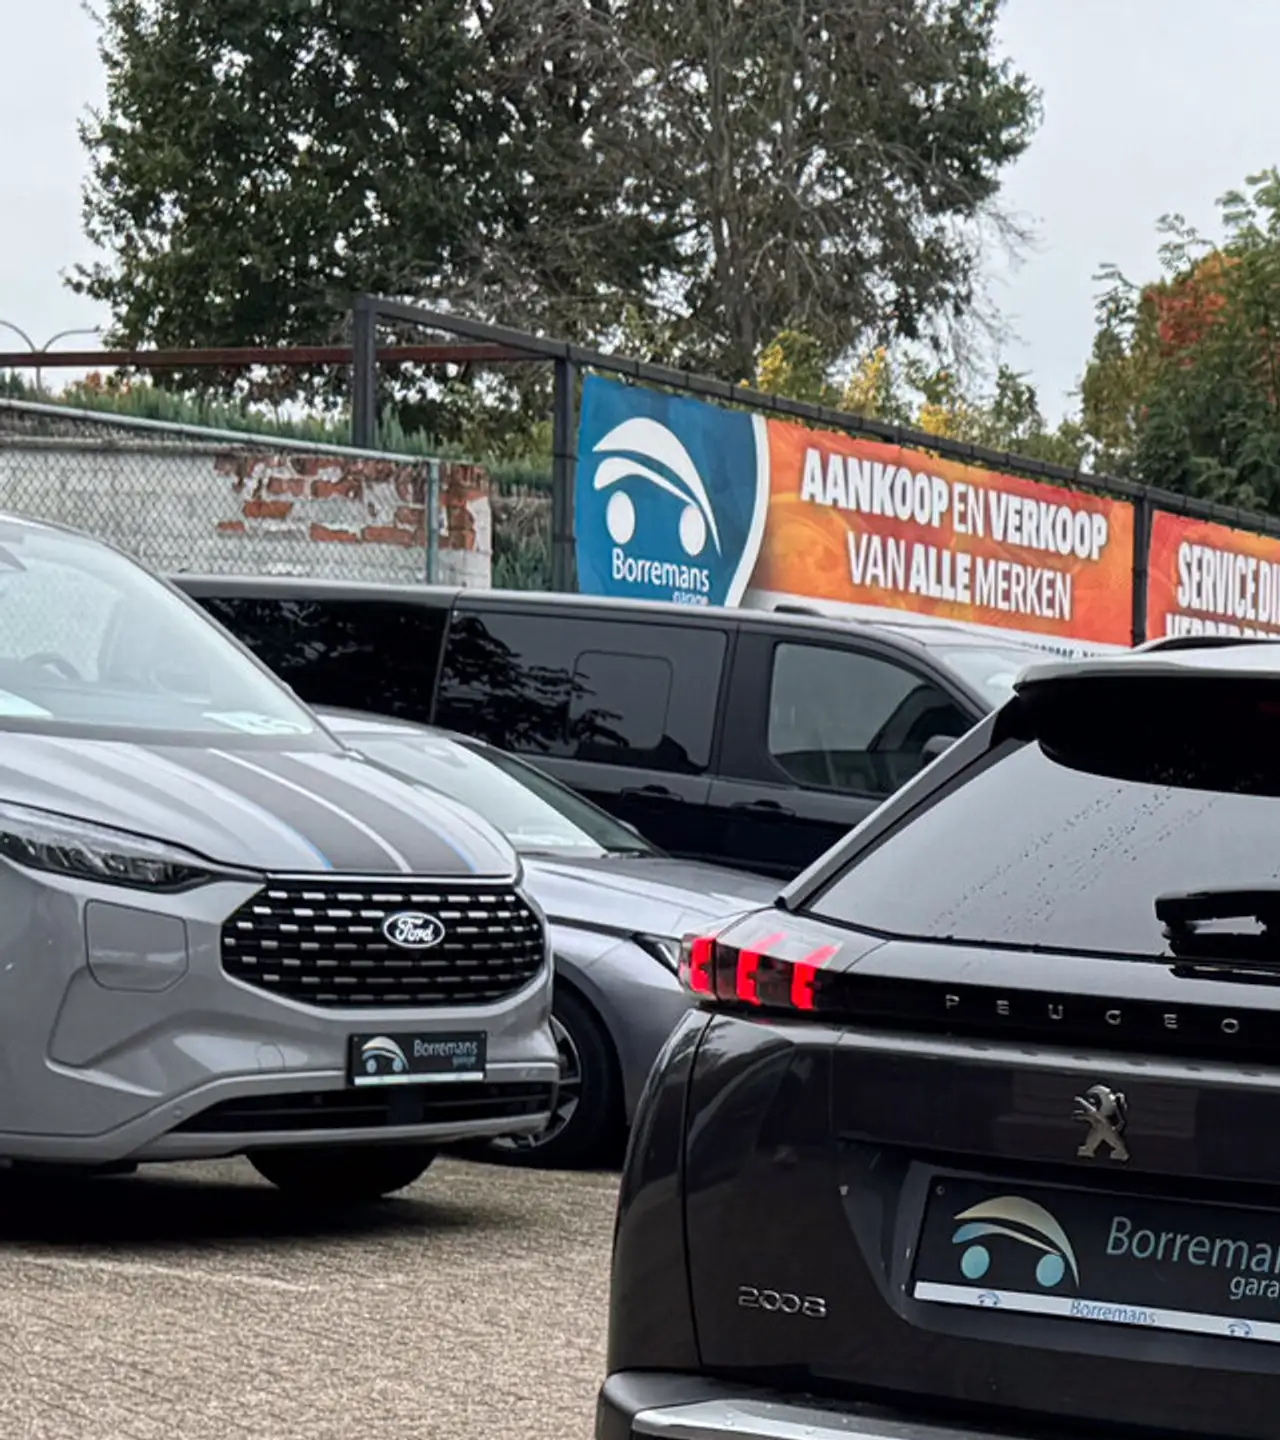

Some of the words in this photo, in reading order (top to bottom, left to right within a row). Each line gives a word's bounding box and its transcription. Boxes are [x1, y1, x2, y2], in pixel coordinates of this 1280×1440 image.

[801, 447, 949, 529] AANKOOP
[952, 481, 985, 539] EN
[987, 489, 1108, 561] VERKOOP
[611, 547, 710, 593] Borremans
[846, 530, 906, 591] VAN
[908, 543, 972, 604] ALLE
[974, 556, 1072, 621] MERKEN
[1177, 541, 1257, 622] SERVICE
[395, 917, 435, 942] Ford
[412, 1039, 478, 1058] Borremans
[738, 1285, 827, 1318] 2008
[1069, 1300, 1157, 1323] Borremans
